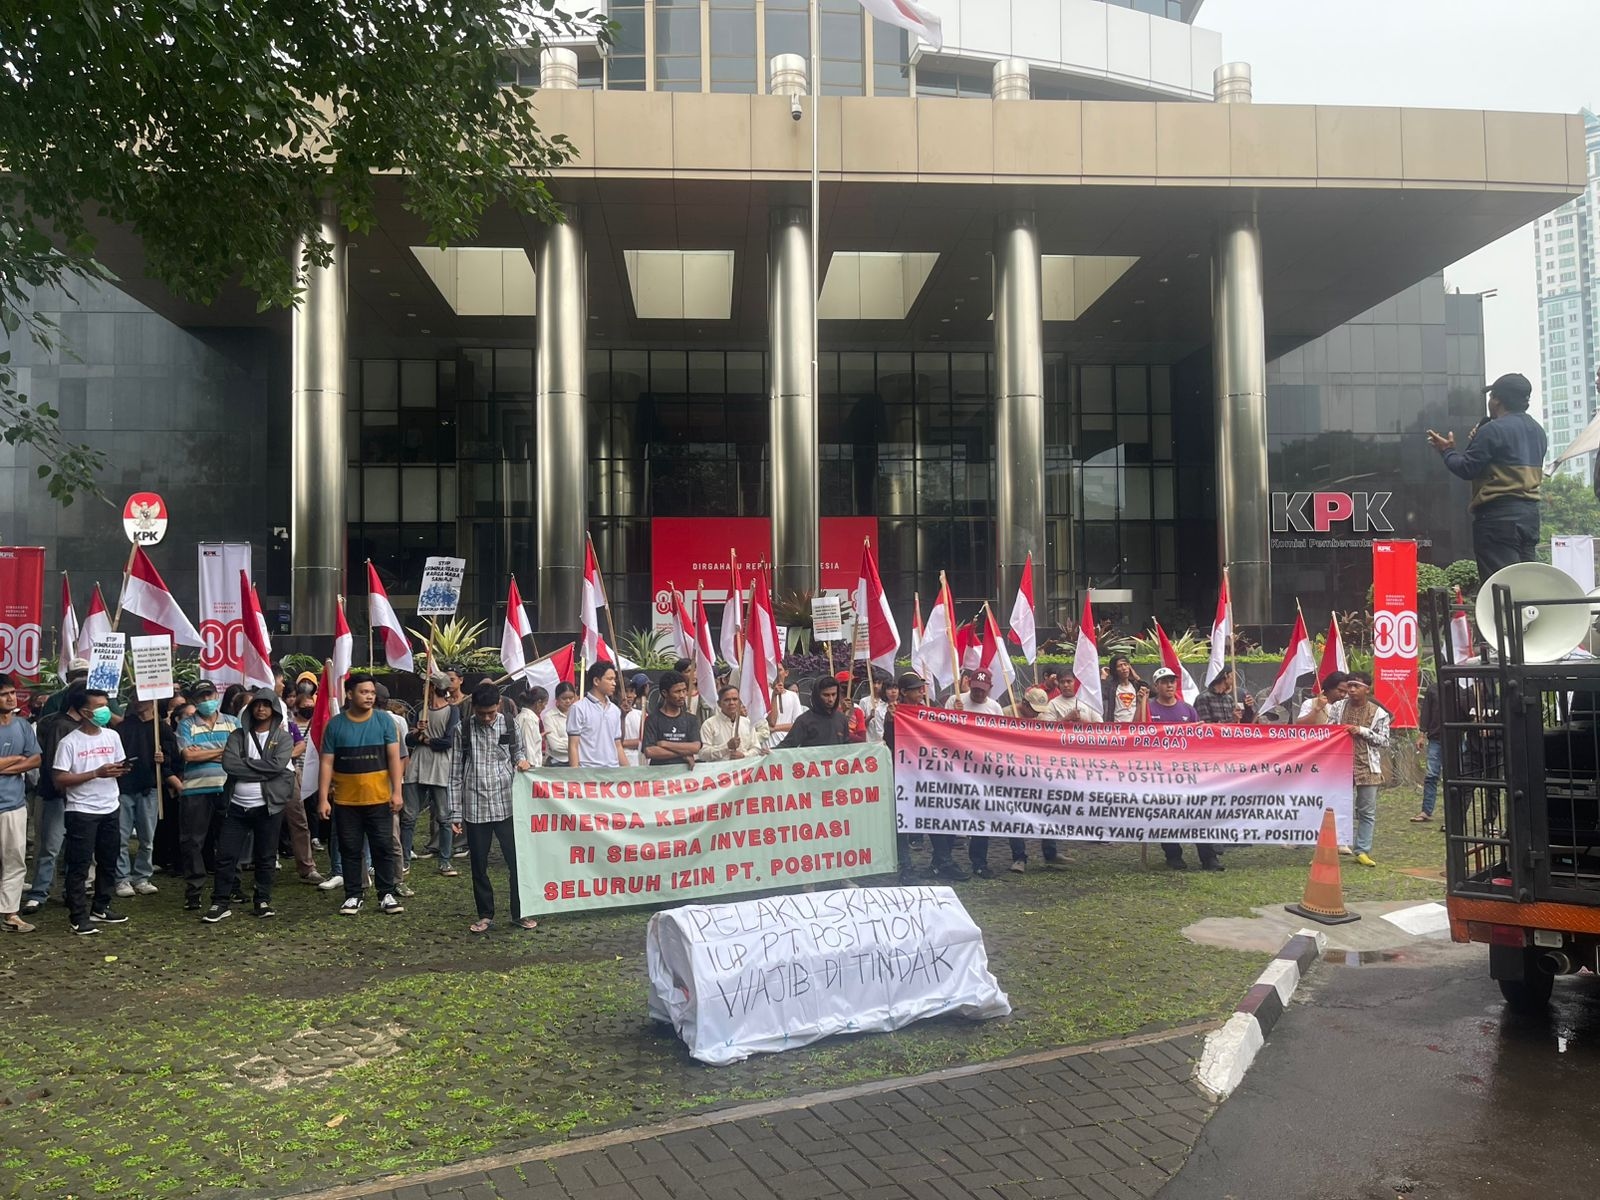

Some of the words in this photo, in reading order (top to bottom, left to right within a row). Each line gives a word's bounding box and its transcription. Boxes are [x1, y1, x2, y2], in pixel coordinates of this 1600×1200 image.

[1272, 492, 1395, 532] KPK
[133, 531, 158, 541] KPK
[1271, 538, 1307, 549] Komisi
[1309, 538, 1373, 549] Pemberanta
[692, 562, 742, 570] DIRGAHAU
[1374, 610, 1417, 658] 80
[918, 710, 967, 725] FRONT
[975, 716, 1065, 733] MAHASISWA
[1073, 723, 1121, 734] MALUT
[1129, 725, 1157, 736] PRO
[1165, 725, 1214, 739] WARGA
[1221, 727, 1260, 738] MABA
[1269, 727, 1331, 741] SANGAJI
[1061, 734, 1126, 746] (FORMAT
[1134, 736, 1188, 750] PRAGA)
[899, 749, 911, 764] 1.
[919, 746, 973, 761] DESAK
[984, 751, 1015, 764] KPK
[1025, 754, 1040, 765] RI
[1050, 756, 1119, 770] PERIKSA
[1128, 760, 1161, 771] IZIN
[1172, 761, 1303, 776] PERTAMBANGAN
[1310, 764, 1319, 773] &
[918, 758, 953, 772] IZIN
[963, 762, 1076, 781] LINGKUNGAN
[1086, 770, 1109, 781] PT.
[1118, 771, 1197, 785] POSITION
[531, 763, 783, 799] MEREKOMENDASIKAN
[792, 755, 879, 780] SATGAS
[530, 812, 645, 833] MINERBA
[656, 789, 812, 827] KEMENTERIAN
[821, 786, 880, 808] ESDM
[896, 785, 908, 801] 2.
[915, 781, 980, 796] MEMINTA
[983, 785, 1042, 800] MENTERI
[1047, 789, 1084, 802] ESDM
[1089, 791, 1138, 806] SEGERA
[1142, 793, 1182, 805] CABUT
[1186, 794, 1207, 806] IUP
[1211, 795, 1227, 806] PT.
[1231, 795, 1285, 807] POSITION
[1291, 795, 1323, 810] YANG
[914, 796, 980, 811] MERUSAK
[984, 799, 1071, 817] LINGKUNGAN
[1075, 806, 1084, 816] &
[1089, 805, 1214, 821] MENYENGSARAKAN
[1215, 808, 1299, 821] MASYARAKAT
[569, 846, 595, 864] RI
[607, 837, 701, 864] SEGERA
[710, 820, 851, 850] INVESTIGASI
[897, 813, 908, 829] 3.
[915, 817, 985, 832] BERANTAS
[991, 820, 1035, 835] MAFIA
[1039, 823, 1103, 840] TAMBANG
[1109, 826, 1144, 841] YANG
[1148, 827, 1239, 842] MEMMBEKING
[1243, 828, 1261, 841] PT.
[544, 874, 662, 901] SELURUH
[672, 866, 716, 889] IZIN
[726, 860, 761, 883] PT.
[771, 847, 873, 877] POSITION
[689, 896, 818, 942] PELAKU
[825, 887, 951, 923] SKANDAL
[707, 943, 748, 973] IUP
[811, 914, 925, 951] POSITION
[717, 962, 810, 1018] WAJIB
[826, 959, 842, 989] DI
[852, 943, 953, 985] TINDAK
